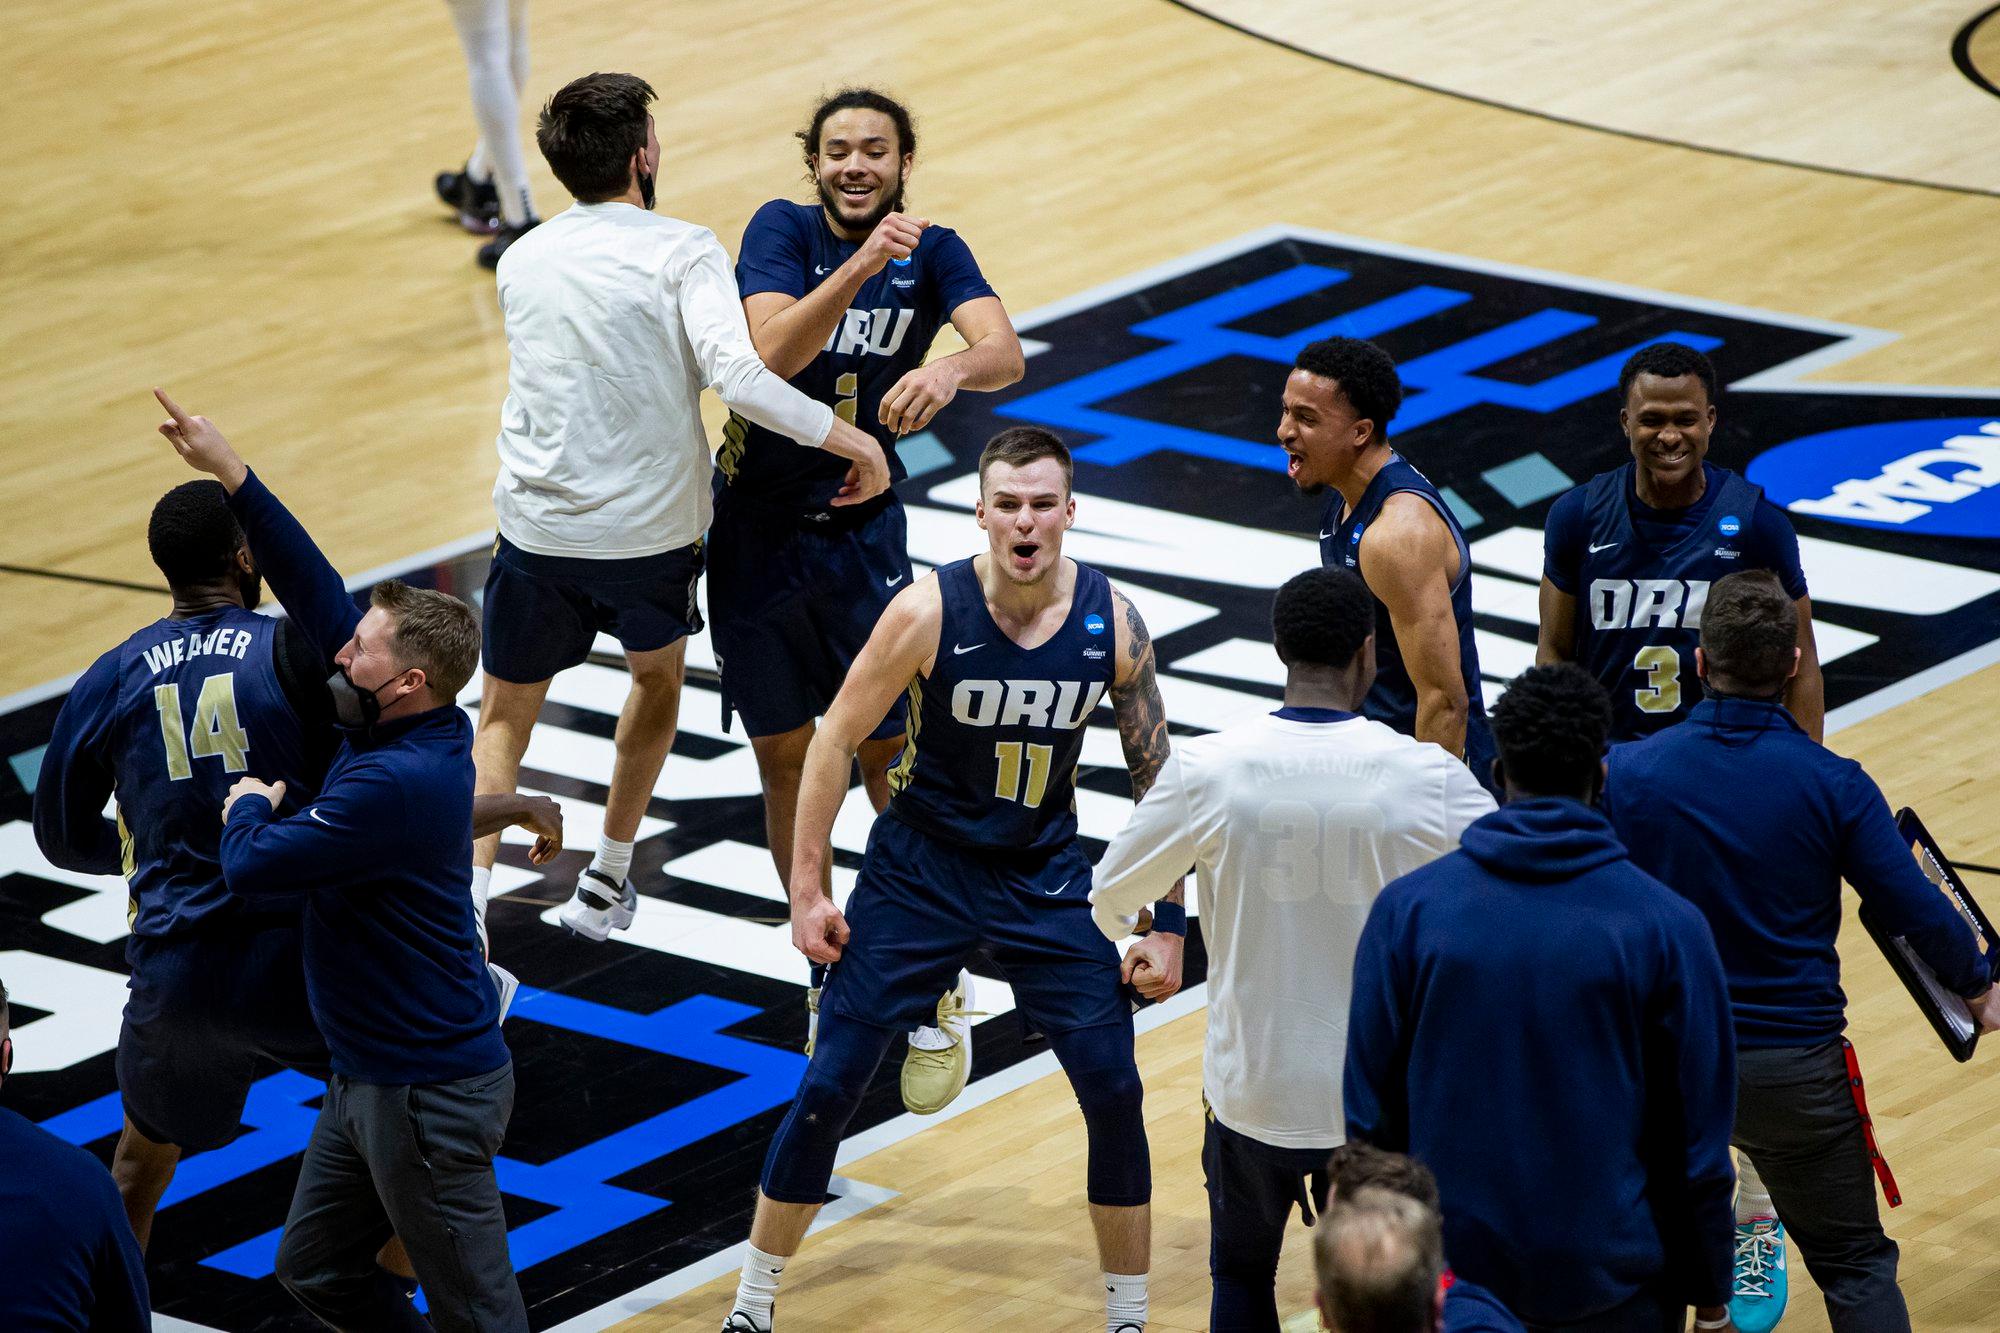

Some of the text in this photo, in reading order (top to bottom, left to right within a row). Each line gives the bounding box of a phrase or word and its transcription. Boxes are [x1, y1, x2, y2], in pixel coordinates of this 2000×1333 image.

[822, 308, 915, 357] RU
[142, 628, 252, 675] WEAVER
[1634, 645, 1681, 713] 3
[154, 672, 250, 781] 14
[951, 679, 1105, 730] ORU
[995, 742, 1053, 808] 11
[1253, 751, 1394, 790] ALEXANDRE
[1259, 800, 1386, 905] 30
[1924, 847, 1949, 881] EXPECT
[1954, 891, 1983, 932] MIRACLE
